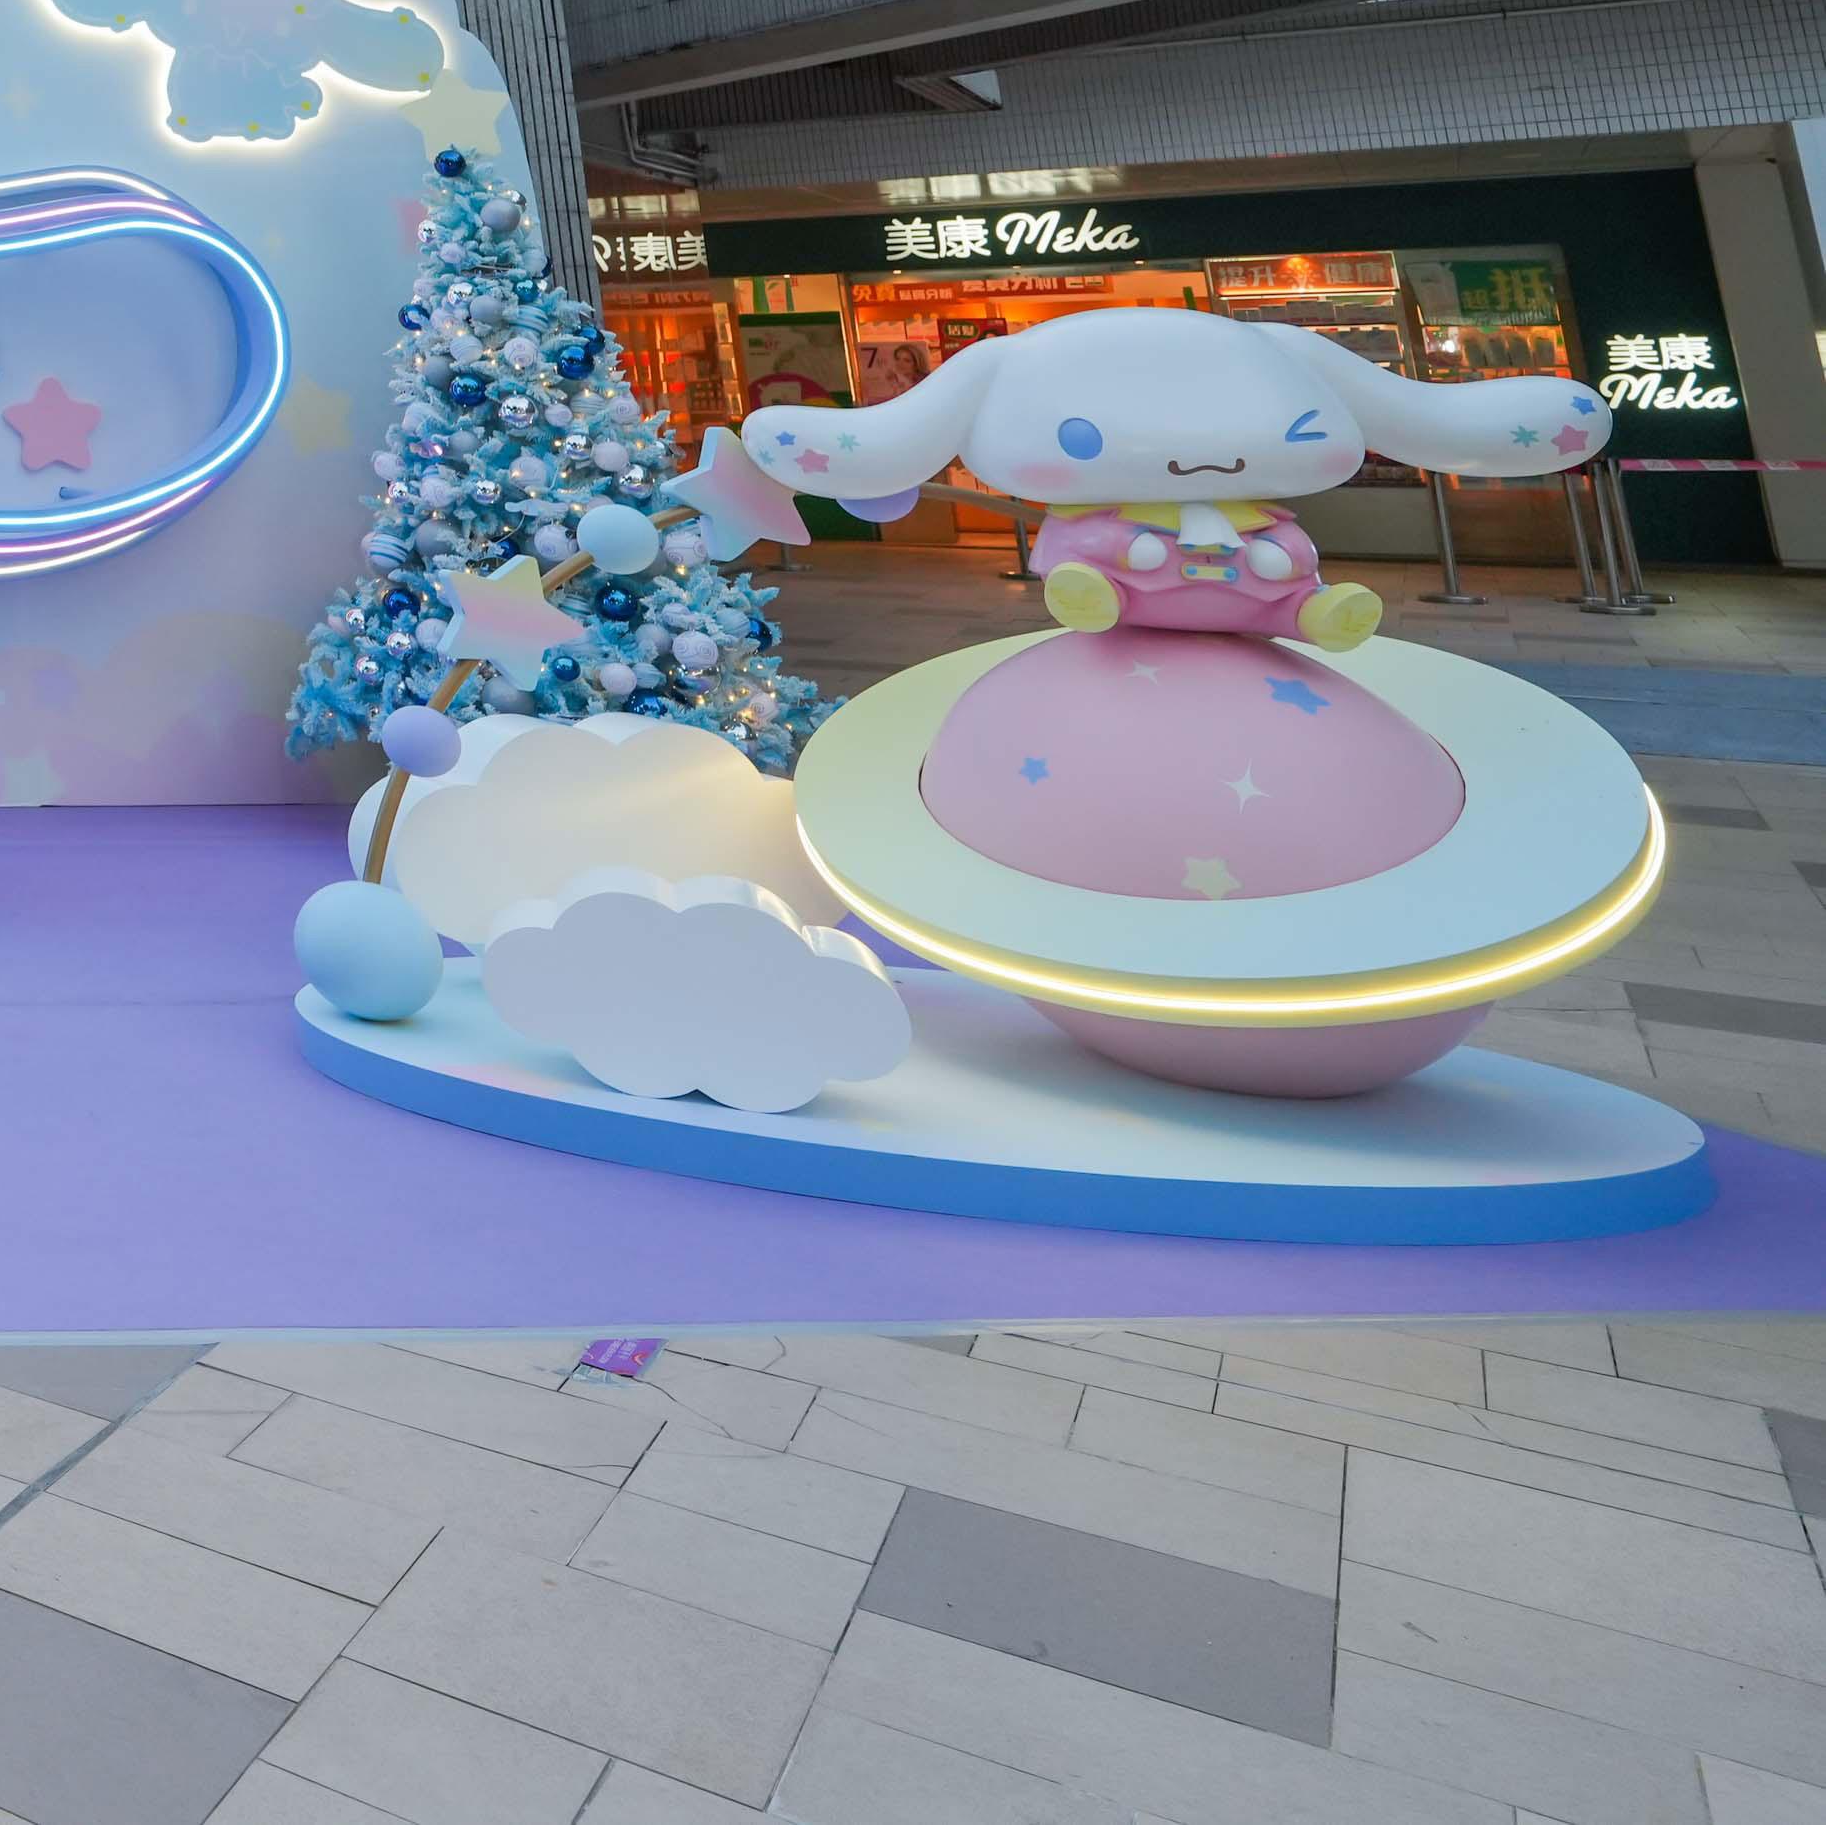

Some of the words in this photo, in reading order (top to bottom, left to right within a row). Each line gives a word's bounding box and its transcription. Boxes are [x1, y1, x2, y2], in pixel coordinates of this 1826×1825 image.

[884, 215, 991, 262] 美康
[996, 208, 1140, 255] Meka
[1606, 332, 1715, 371] 美康
[1599, 372, 1738, 410] Meka
